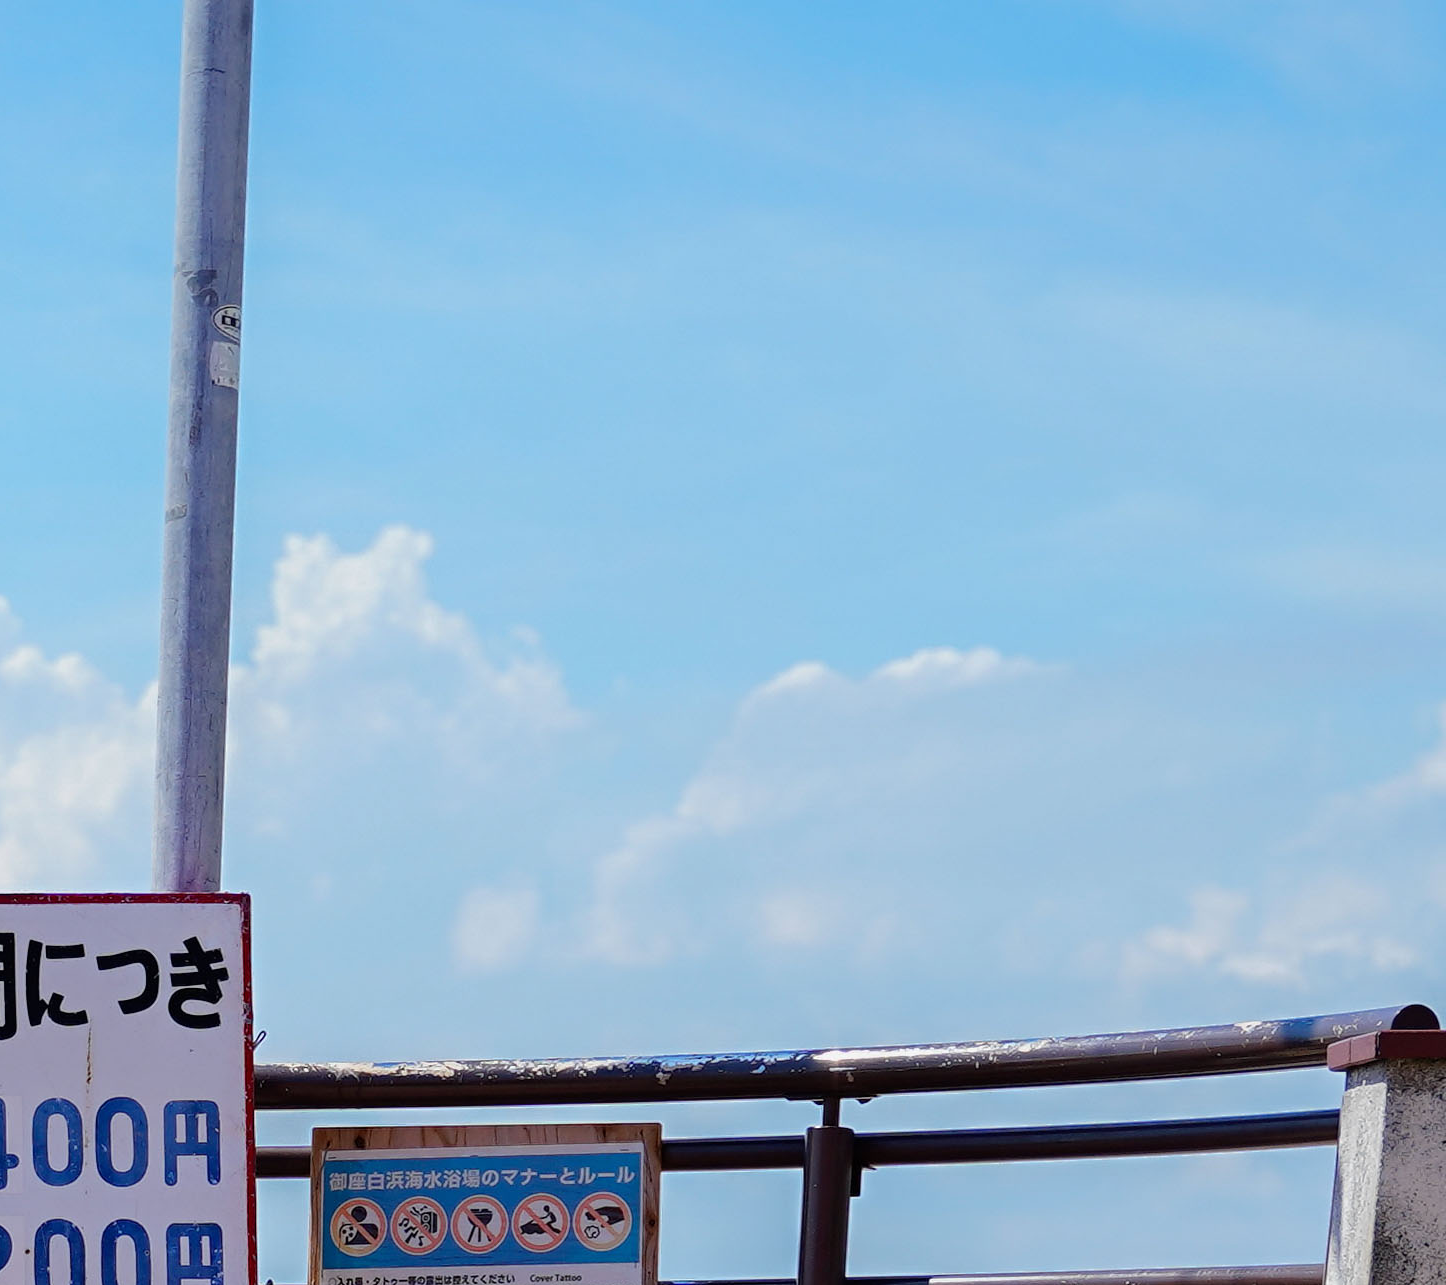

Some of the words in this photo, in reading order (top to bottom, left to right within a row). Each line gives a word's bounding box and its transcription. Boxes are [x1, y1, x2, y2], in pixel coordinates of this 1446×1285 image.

[329, 1166, 636, 1191] 御座白浜海水浴場のマナーとルール
[529, 1274, 554, 1283] Cover
[555, 1273, 583, 1283] Tattoo
